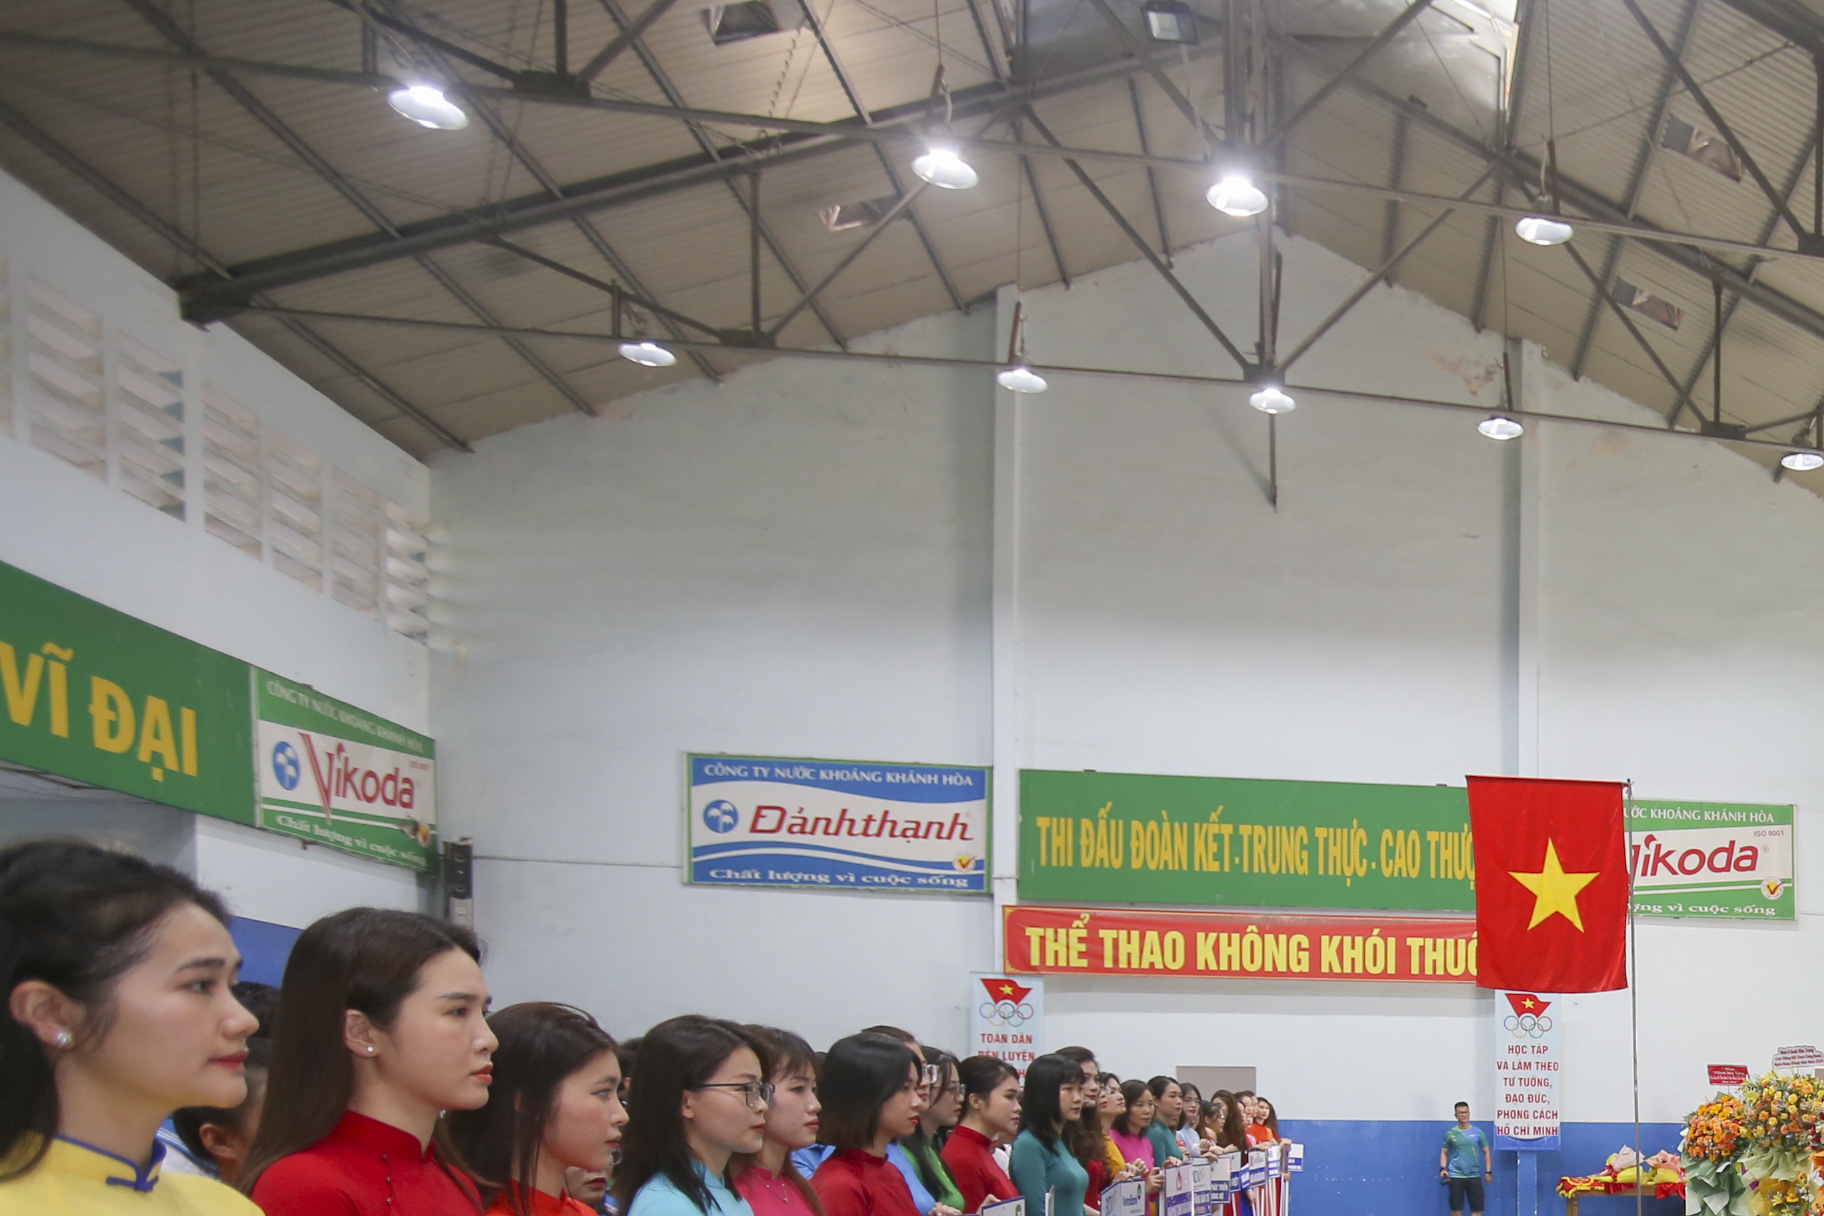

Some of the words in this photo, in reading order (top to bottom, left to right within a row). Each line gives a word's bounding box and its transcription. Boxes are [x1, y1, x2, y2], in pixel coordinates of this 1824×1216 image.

[0, 641, 73, 738] VĨ
[89, 675, 198, 782] ĐẠI
[298, 732, 415, 825] Vikoda
[704, 763, 748, 777] CÔNG
[752, 766, 769, 778] TY
[774, 765, 816, 780] NƯỚC
[820, 767, 883, 783] KHOÁNG
[886, 768, 938, 785] KHÁNH
[943, 770, 973, 786] HÒA
[1650, 806, 1701, 821] KHOÁNG
[1704, 807, 1746, 822] KHÁNH
[1750, 809, 1775, 823] HÒA
[1036, 816, 1074, 867] THI
[1080, 801, 1124, 869] ĐẤU
[1130, 809, 1188, 871] ĐOÀN
[1194, 805, 1234, 872] KẾT
[1239, 824, 1309, 876] TRUNG
[1315, 818, 1368, 888] THỰC
[1380, 828, 1421, 878] CAO
[709, 868, 763, 881] Chất
[768, 869, 831, 885] lượng
[835, 871, 856, 883] vì
[861, 871, 913, 886] cuộc
[917, 872, 969, 888] sống
[1667, 902, 1684, 912] vì
[1688, 904, 1729, 915] cuộc
[1734, 904, 1776, 916] sống
[1025, 912, 1091, 968] THỂ
[1098, 929, 1186, 970] THAO
[1196, 924, 1310, 972] KHÔNG
[1320, 928, 1397, 975] KHÓI
[980, 1032, 1008, 1044] TOÀN
[1011, 1031, 1033, 1044] DÂN
[1507, 1045, 1528, 1056] HỌC
[1530, 1042, 1549, 1057] TẬP
[1496, 1058, 1509, 1071] VÀ
[1512, 1059, 1532, 1071] LÀM
[1535, 1061, 1560, 1071] THEO
[1503, 1076, 1516, 1087] TƯ
[1505, 1093, 1525, 1106] ĐẠO
[1527, 1091, 1551, 1105] ĐỨC,
[1497, 1109, 1530, 1120] PHONG
[1532, 1107, 1558, 1120] CÁCH
[1497, 1122, 1510, 1136] HỒ
[1513, 1124, 1530, 1136] CHÍ
[1533, 1126, 1559, 1136] MINH
